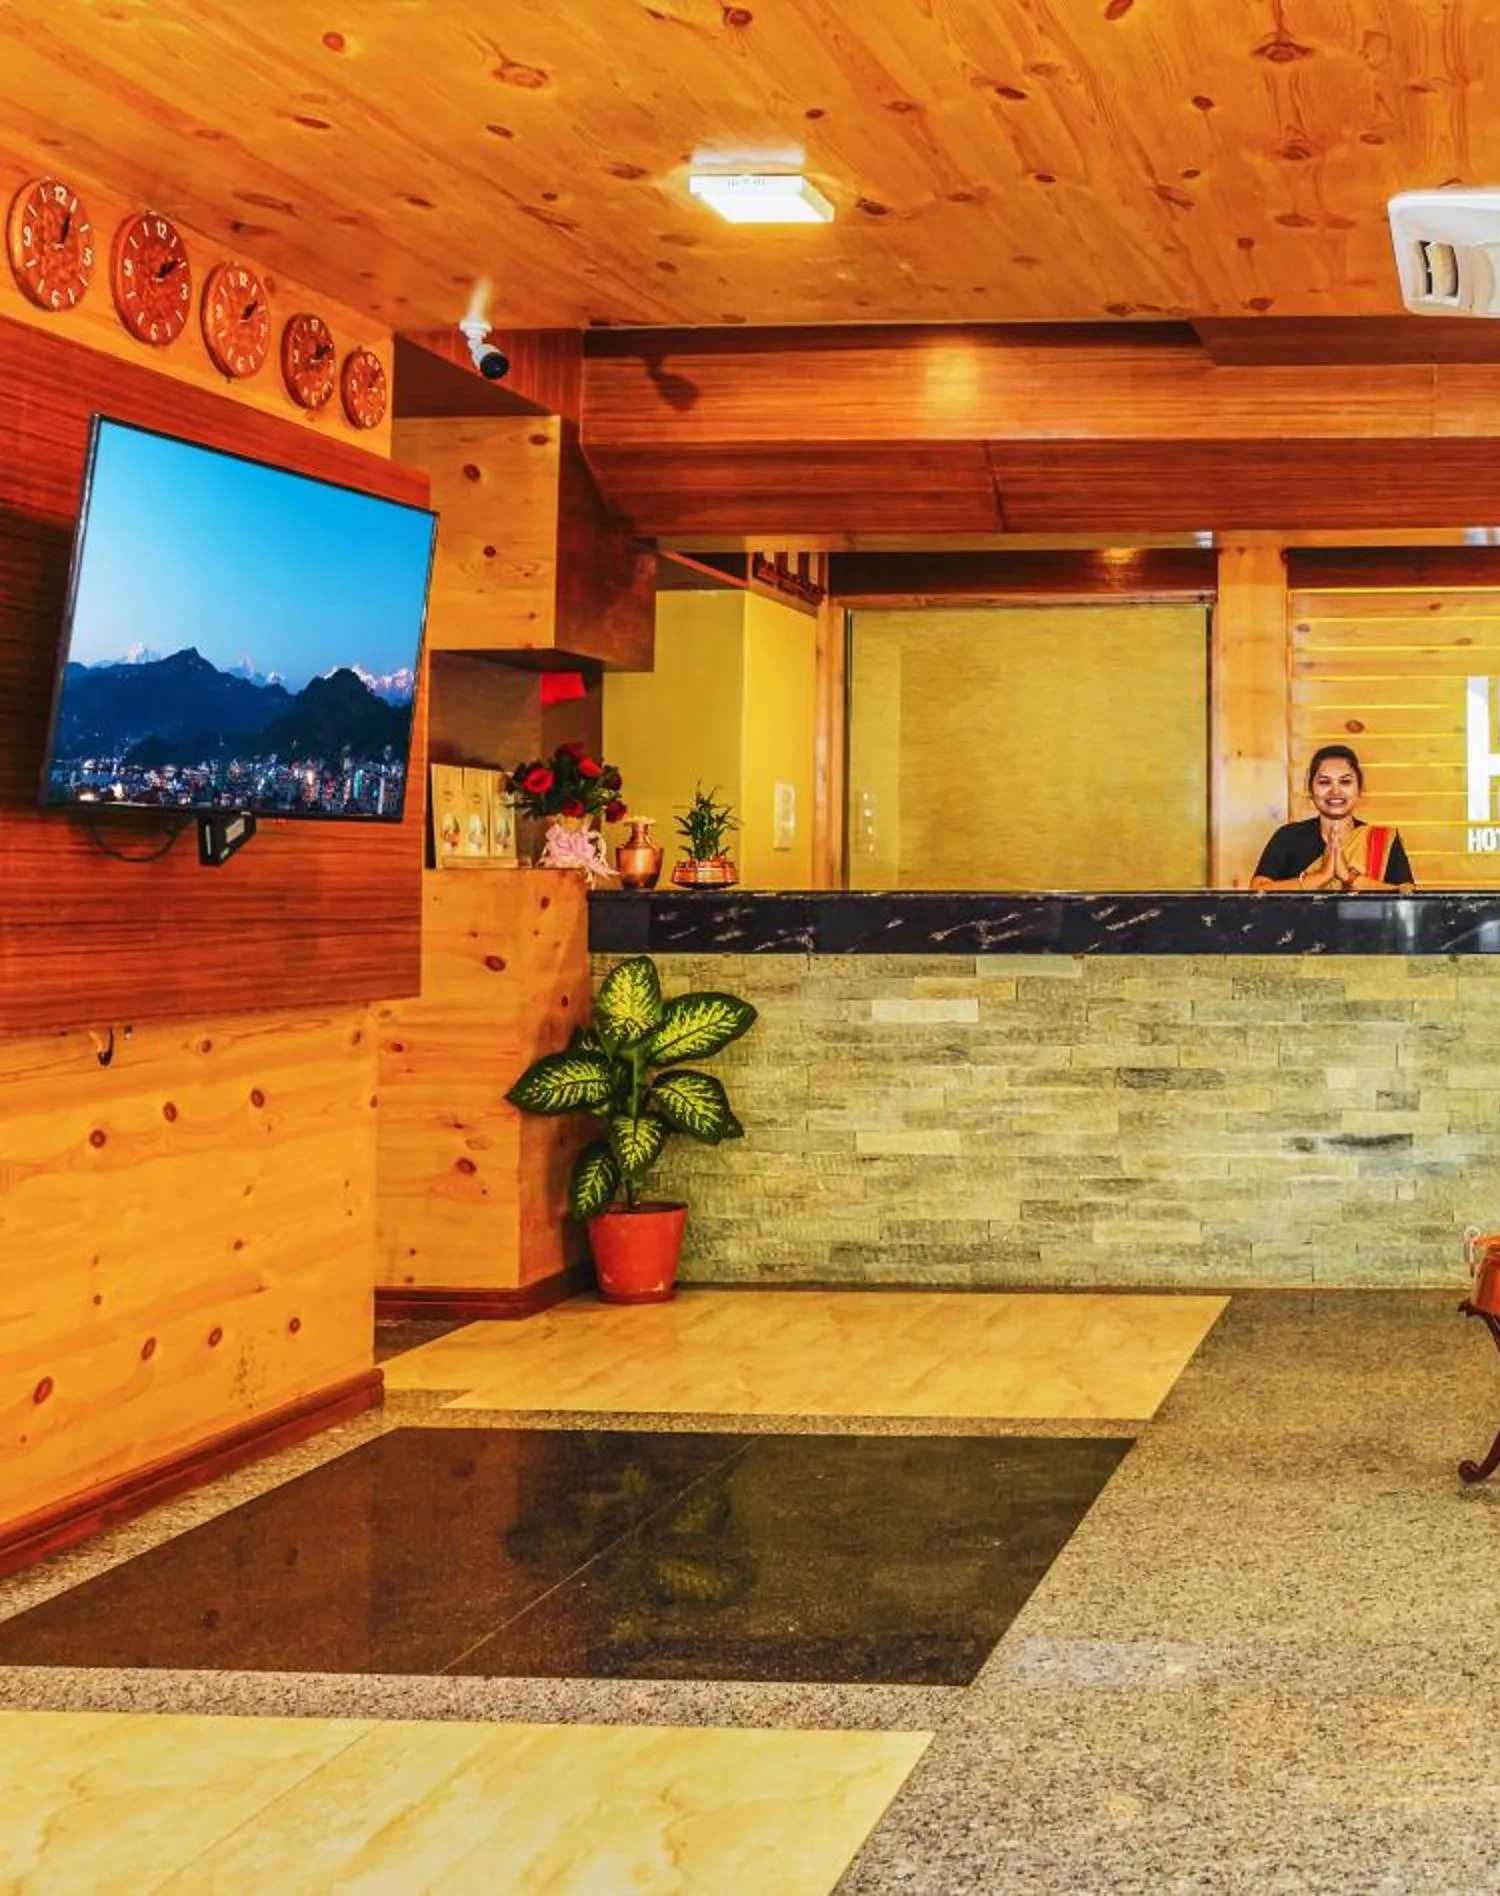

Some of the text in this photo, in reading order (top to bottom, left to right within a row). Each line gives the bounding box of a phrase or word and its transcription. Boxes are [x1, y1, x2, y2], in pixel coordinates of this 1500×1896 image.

[54, 185, 67, 206] 12
[23, 225, 32, 247] 9
[156, 221, 167, 240] 12
[82, 247, 93, 266] 3
